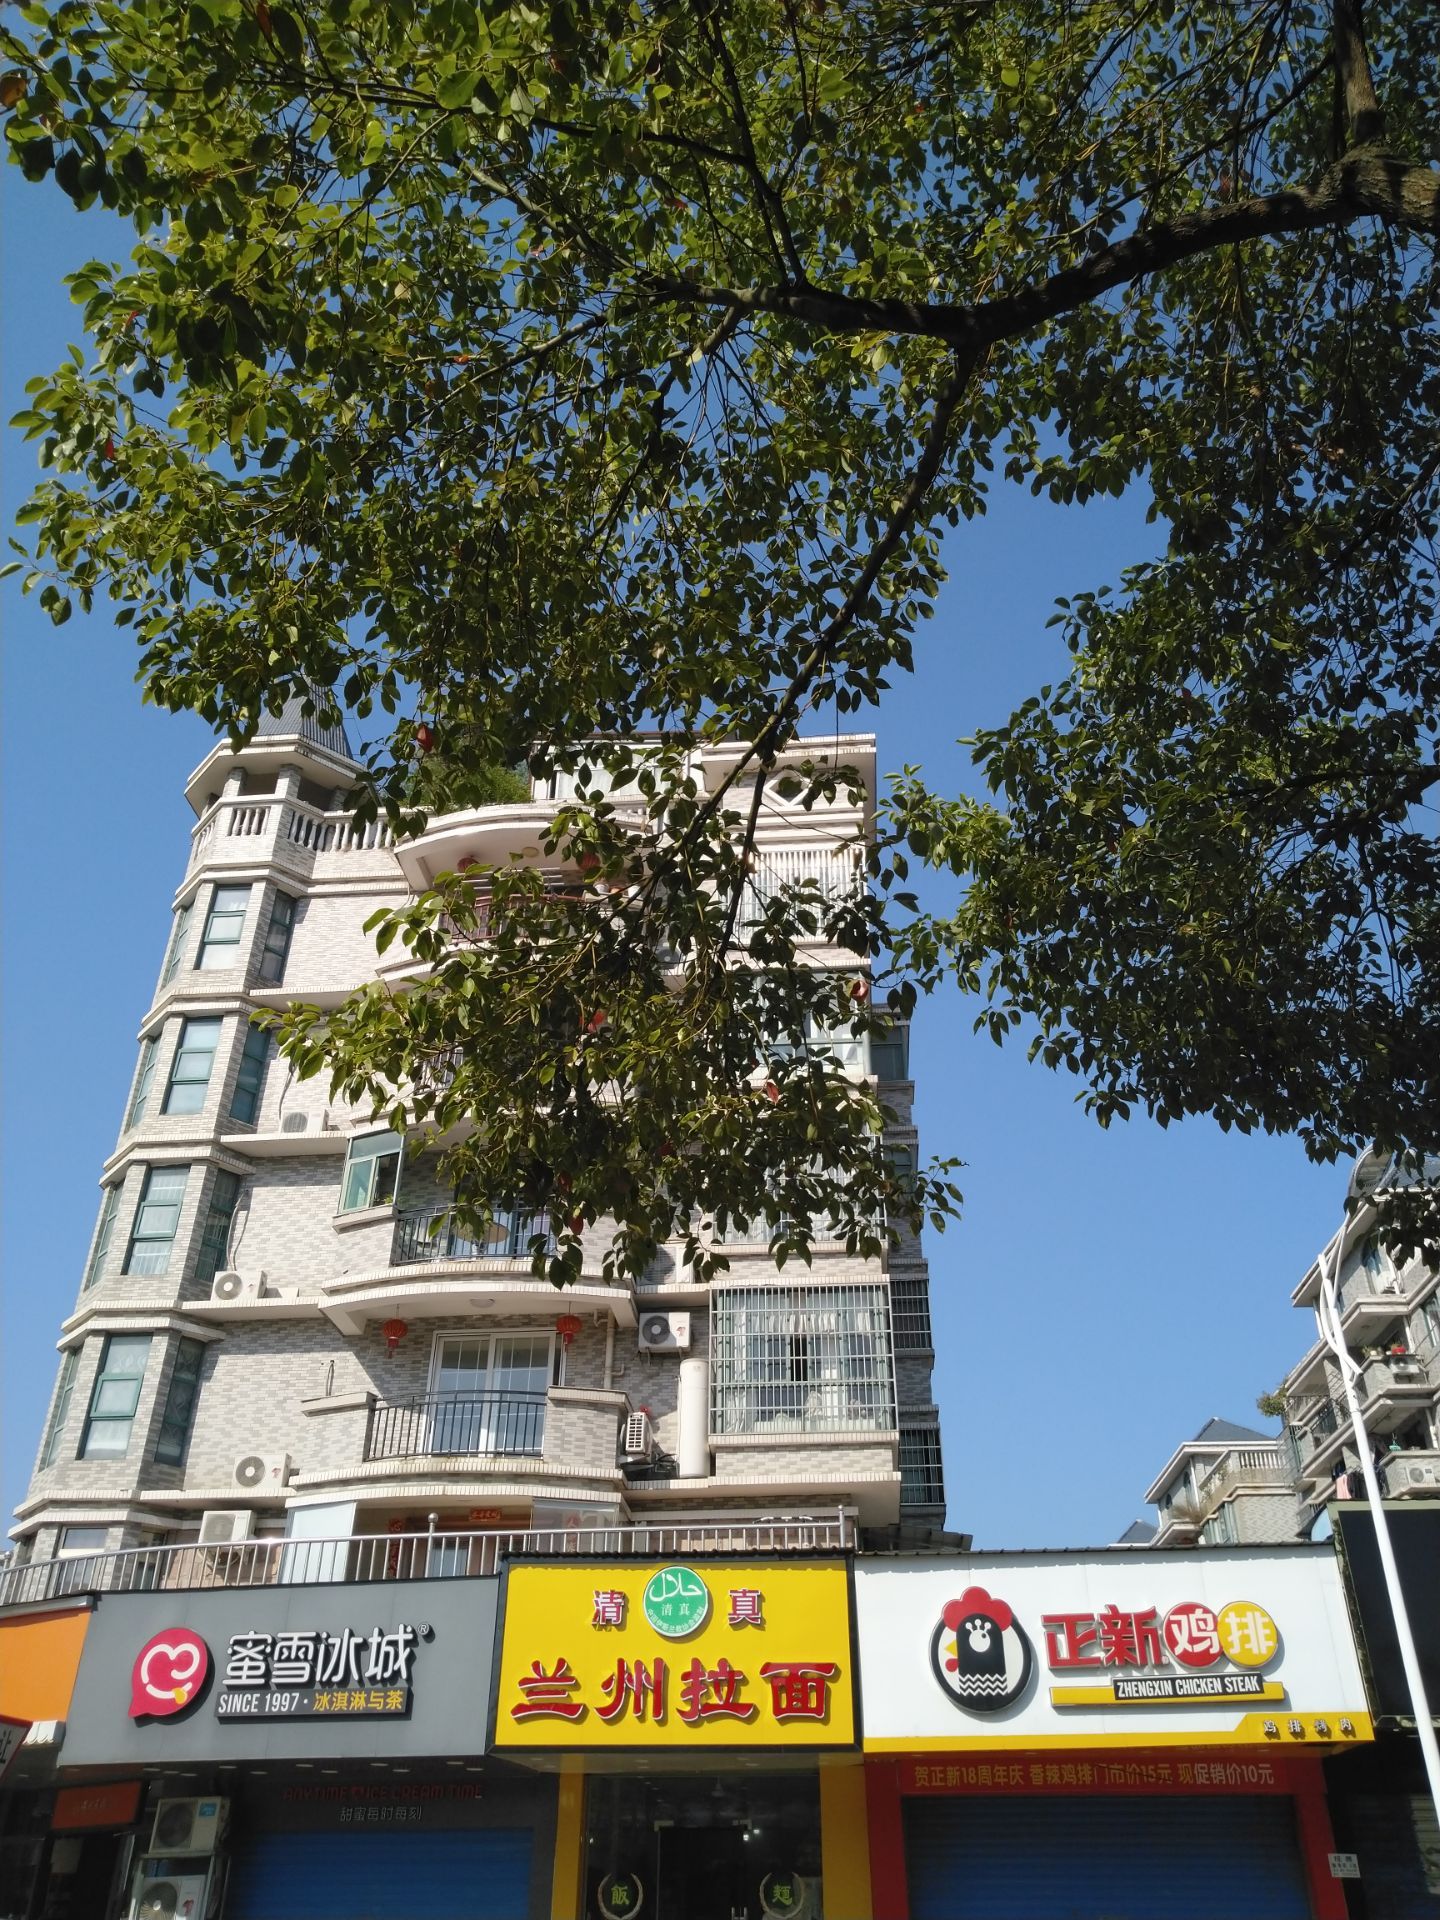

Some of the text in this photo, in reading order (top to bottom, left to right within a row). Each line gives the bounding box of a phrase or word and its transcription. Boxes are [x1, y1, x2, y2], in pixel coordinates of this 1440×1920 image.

[648, 1572, 703, 1602] حلال
[592, 1588, 761, 1625] 清 真
[1041, 1604, 1275, 1669] 正新鸡排
[222, 1623, 414, 1685] 蜜雪冰城
[218, 1690, 404, 1714] SINCE 1997 冰淇淋与茶
[510, 1657, 838, 1721] 兰州拉面
[1117, 1676, 1260, 1699] ZHENGXIN CHICKEN STEAK
[914, 1762, 1275, 1787] 贺正新18周年庆 香辣鸡排门市价15元 现促销价10元
